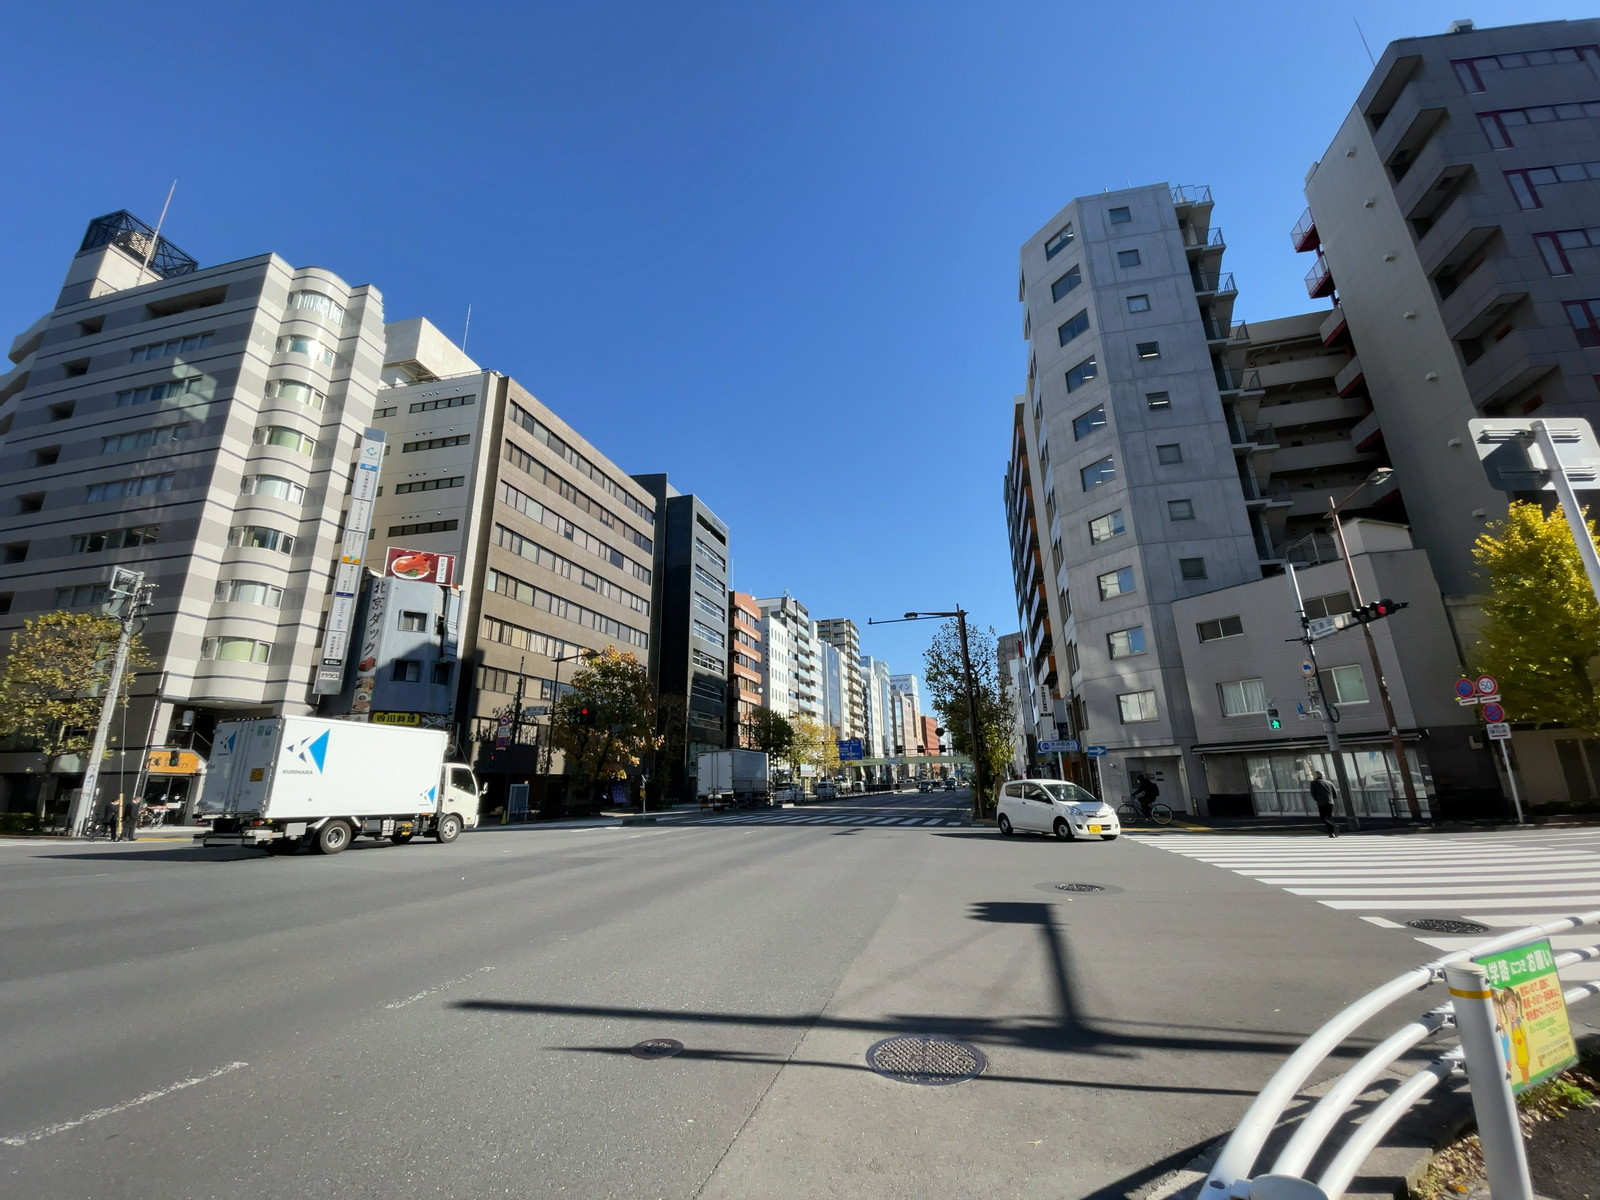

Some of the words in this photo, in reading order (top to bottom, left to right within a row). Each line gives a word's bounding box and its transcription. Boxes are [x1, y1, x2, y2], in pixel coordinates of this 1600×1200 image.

[364, 581, 386, 656] 北京ダック
[1480, 681, 1493, 690] 50
[376, 714, 416, 723] 四川料理
